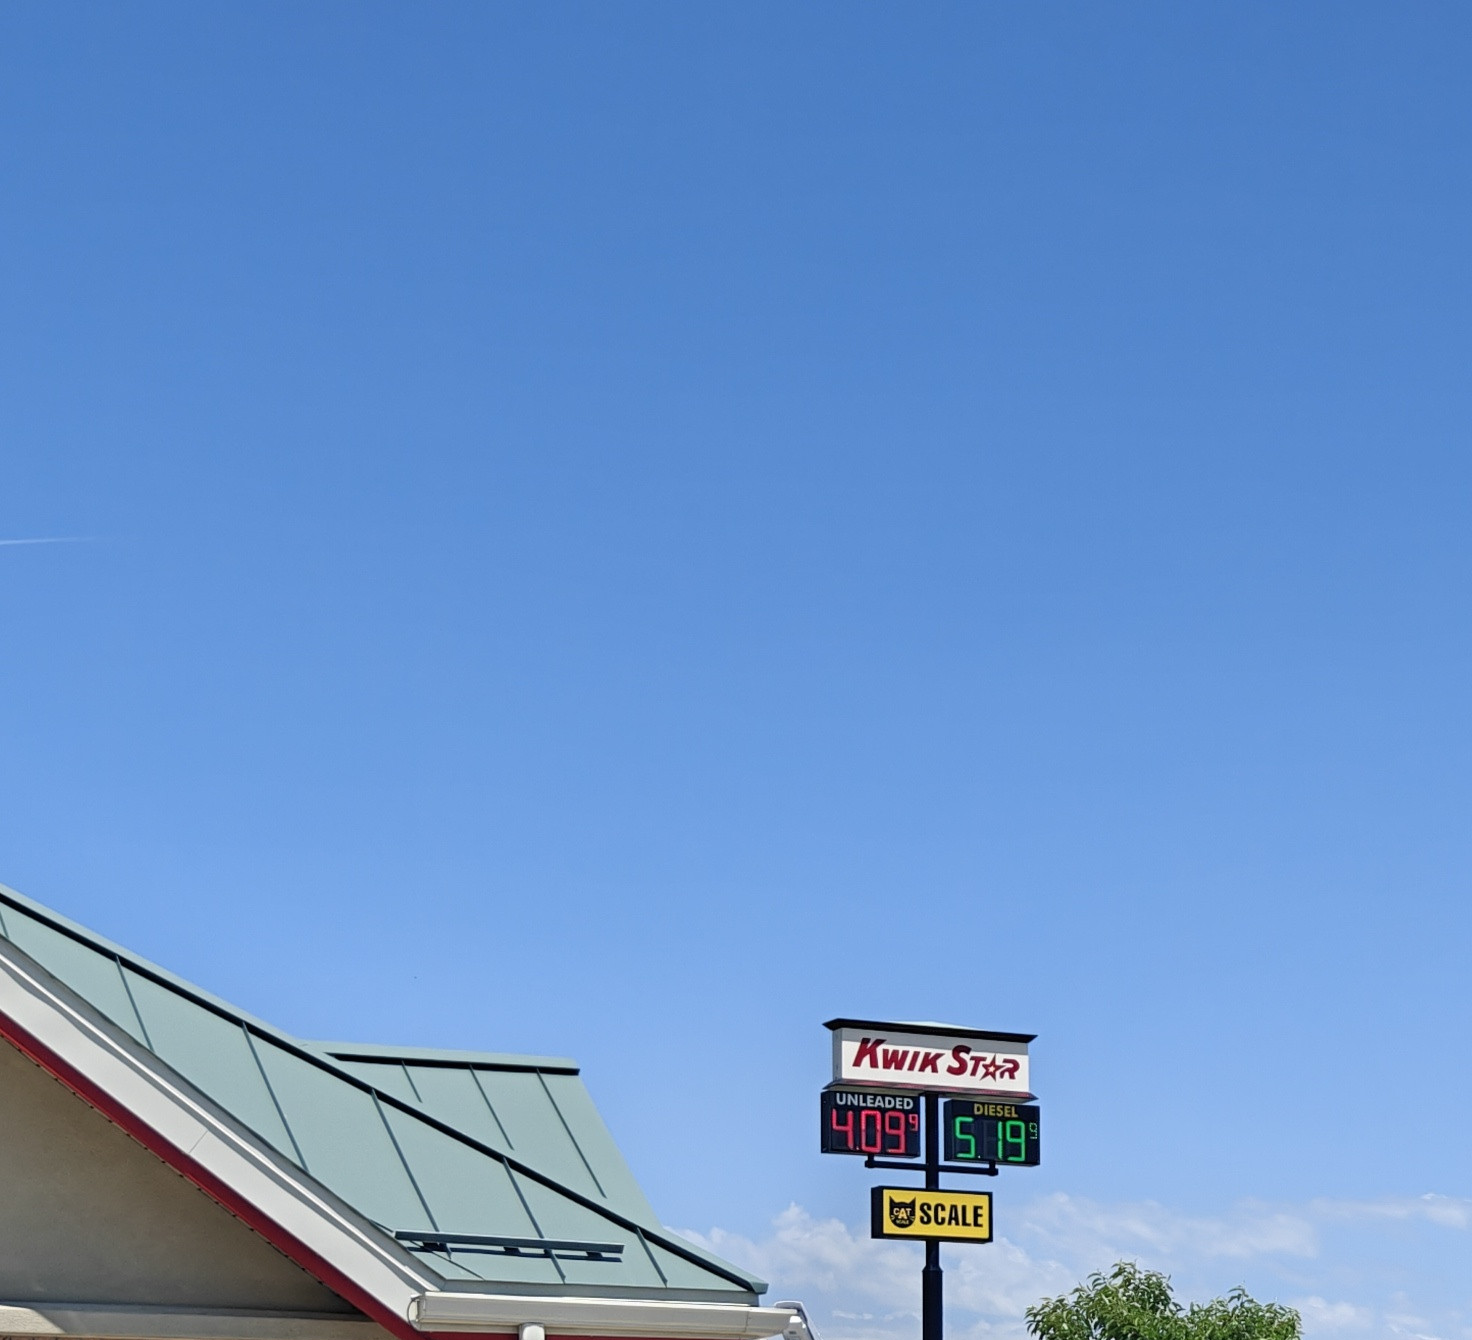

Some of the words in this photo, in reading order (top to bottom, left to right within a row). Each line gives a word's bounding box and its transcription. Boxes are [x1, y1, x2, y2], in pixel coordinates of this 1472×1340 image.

[852, 1037, 946, 1073] KWIK
[946, 1044, 1020, 1082] STAR
[836, 1093, 914, 1110] UNLEADED
[974, 1104, 1018, 1118] DIESEL
[893, 1207, 912, 1220] CAT
[919, 1203, 984, 1227] SCALE
